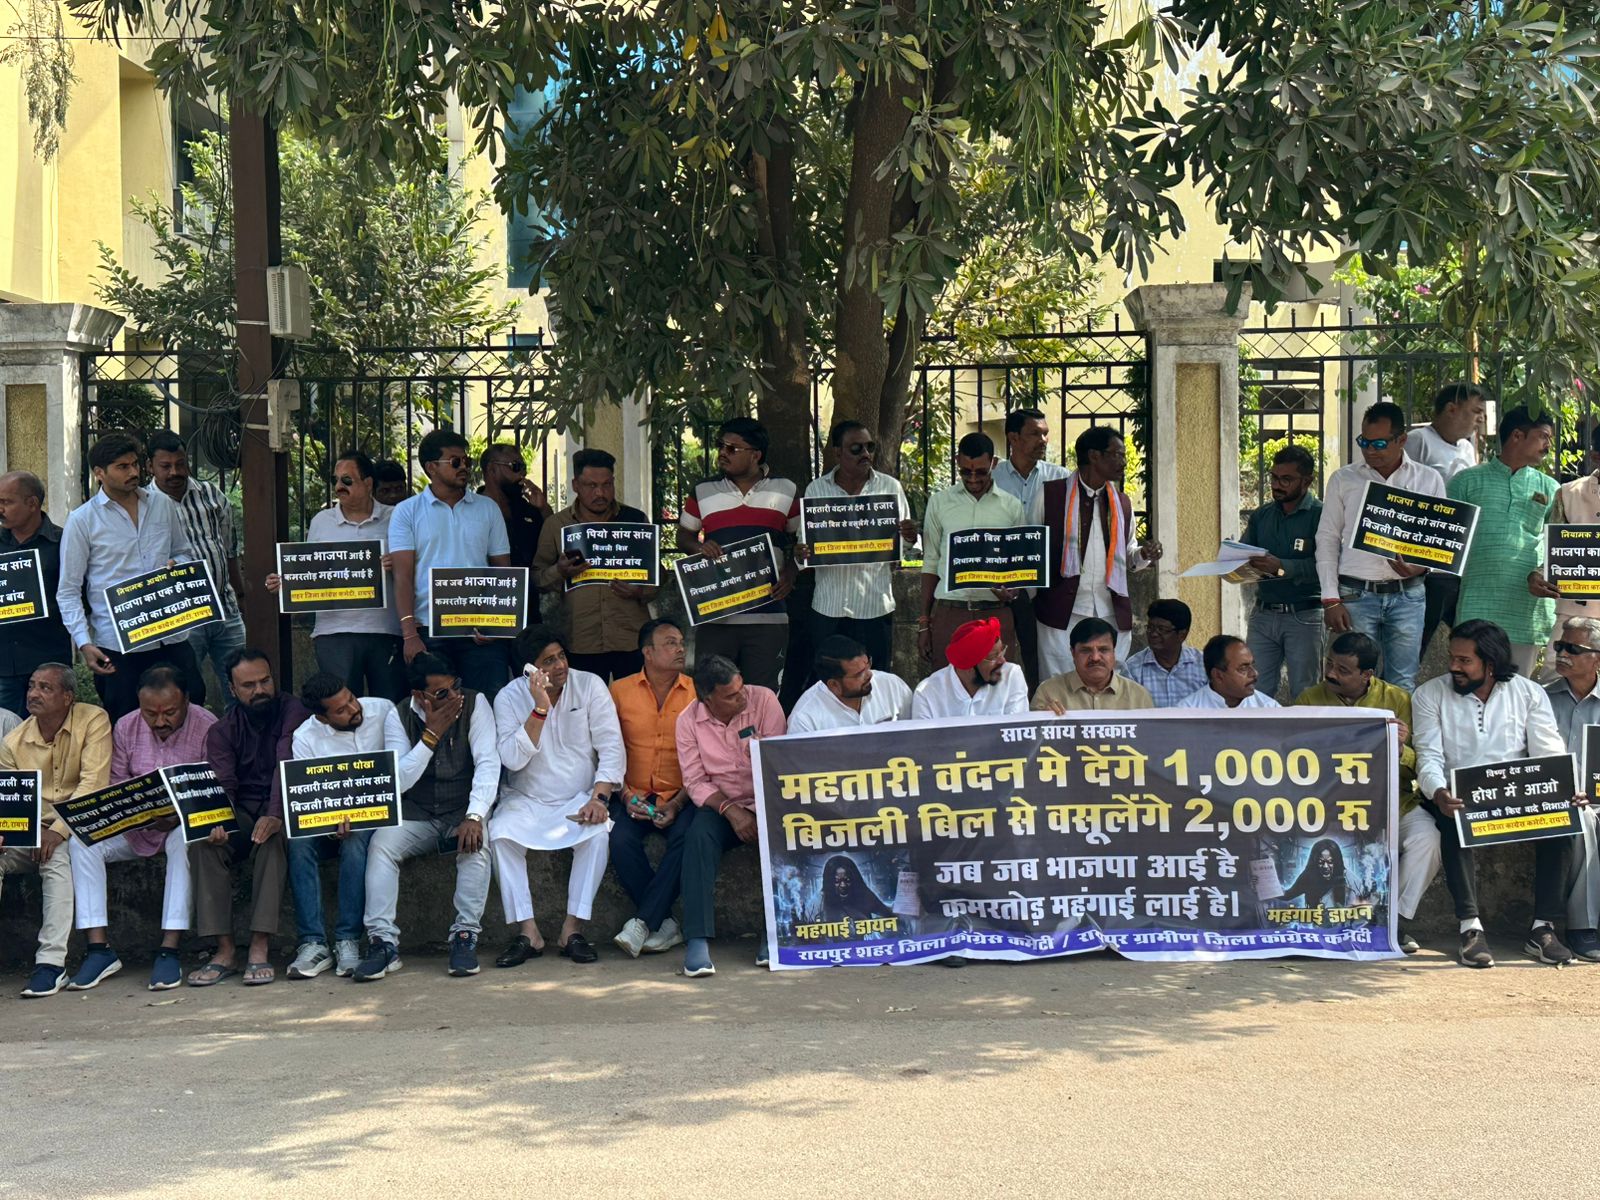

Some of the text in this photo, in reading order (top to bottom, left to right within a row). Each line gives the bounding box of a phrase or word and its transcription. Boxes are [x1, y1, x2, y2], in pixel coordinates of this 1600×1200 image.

[873, 501, 895, 511] हजार
[1386, 493, 1456, 515] भाजपा का धोखा
[876, 517, 897, 526] हजार
[1366, 503, 1468, 534] महतारी वंदन लो सांय सांय
[586, 528, 608, 539] पियो
[611, 528, 632, 539] सांय
[632, 528, 653, 540] सांय
[953, 530, 1042, 545] बिजली बिल कम करो
[1362, 517, 1464, 551] बिजली बिल दो आंय बांय
[1560, 529, 1592, 538] नियामक
[283, 549, 372, 562] जब जब भाजपा आई है
[604, 555, 642, 566] आंय बांय
[1011, 554, 1024, 562] भंग
[1027, 553, 1041, 562] करो
[1551, 547, 1600, 557] भाजपा का
[318, 568, 350, 580] महंगाई
[351, 568, 366, 579] लाई
[367, 567, 374, 578] है
[1551, 564, 1600, 576] बिजली का
[434, 579, 448, 588] जब
[464, 577, 497, 586] भाजपा
[497, 577, 511, 588] आई
[511, 577, 517, 588] है
[113, 578, 207, 614] भाजपा का एक ही काम
[468, 593, 498, 607] महंगाई
[498, 595, 511, 607] लाई
[511, 595, 517, 607] है
[118, 611, 149, 631] बिजली
[149, 608, 163, 619] का
[192, 594, 212, 605] दाम
[1000, 724, 1137, 743] साय साय सरकार
[305, 759, 374, 775] भाजपा का धोखा
[778, 756, 922, 805] महतारी
[932, 752, 1027, 793] वंदन
[1036, 745, 1071, 787] मे
[1075, 744, 1148, 787] देंगे
[1163, 748, 1320, 796] 1,000
[1524, 764, 1541, 773] साय
[289, 773, 391, 794] महतारी वंदन लो सांय सांय
[1471, 778, 1559, 803] होश में आओ
[290, 790, 394, 813] बिजली बिल दो आंय बांय
[1465, 800, 1571, 820] जनता को किए वादे निभाओ
[782, 807, 908, 851] बिजली
[917, 802, 997, 841] बिल
[1005, 796, 1037, 836] से
[1045, 793, 1172, 845] वसूलेंगे
[1184, 797, 1326, 842] 2,000
[934, 861, 984, 884] जब
[991, 858, 1039, 882] जब
[1047, 856, 1138, 879] भाजपा
[1147, 848, 1208, 881] आई
[1210, 848, 1239, 878] है
[939, 891, 1045, 926] कमरतोड़
[1050, 886, 1136, 920] महंगाई
[1144, 886, 1201, 920] लाई
[1267, 904, 1374, 925] महंगाई डायन
[795, 916, 898, 940] महंगाई डायन
[798, 947, 851, 964] रायपुर
[855, 943, 895, 959] शहर
[898, 936, 947, 955] जिला
[1007, 933, 1054, 951] कमेटी
[1131, 929, 1198, 946] ग्रामीण
[1204, 928, 1254, 946] जिला
[1261, 927, 1319, 945] कांग्रेस
[1325, 926, 1372, 944] कमेटी
